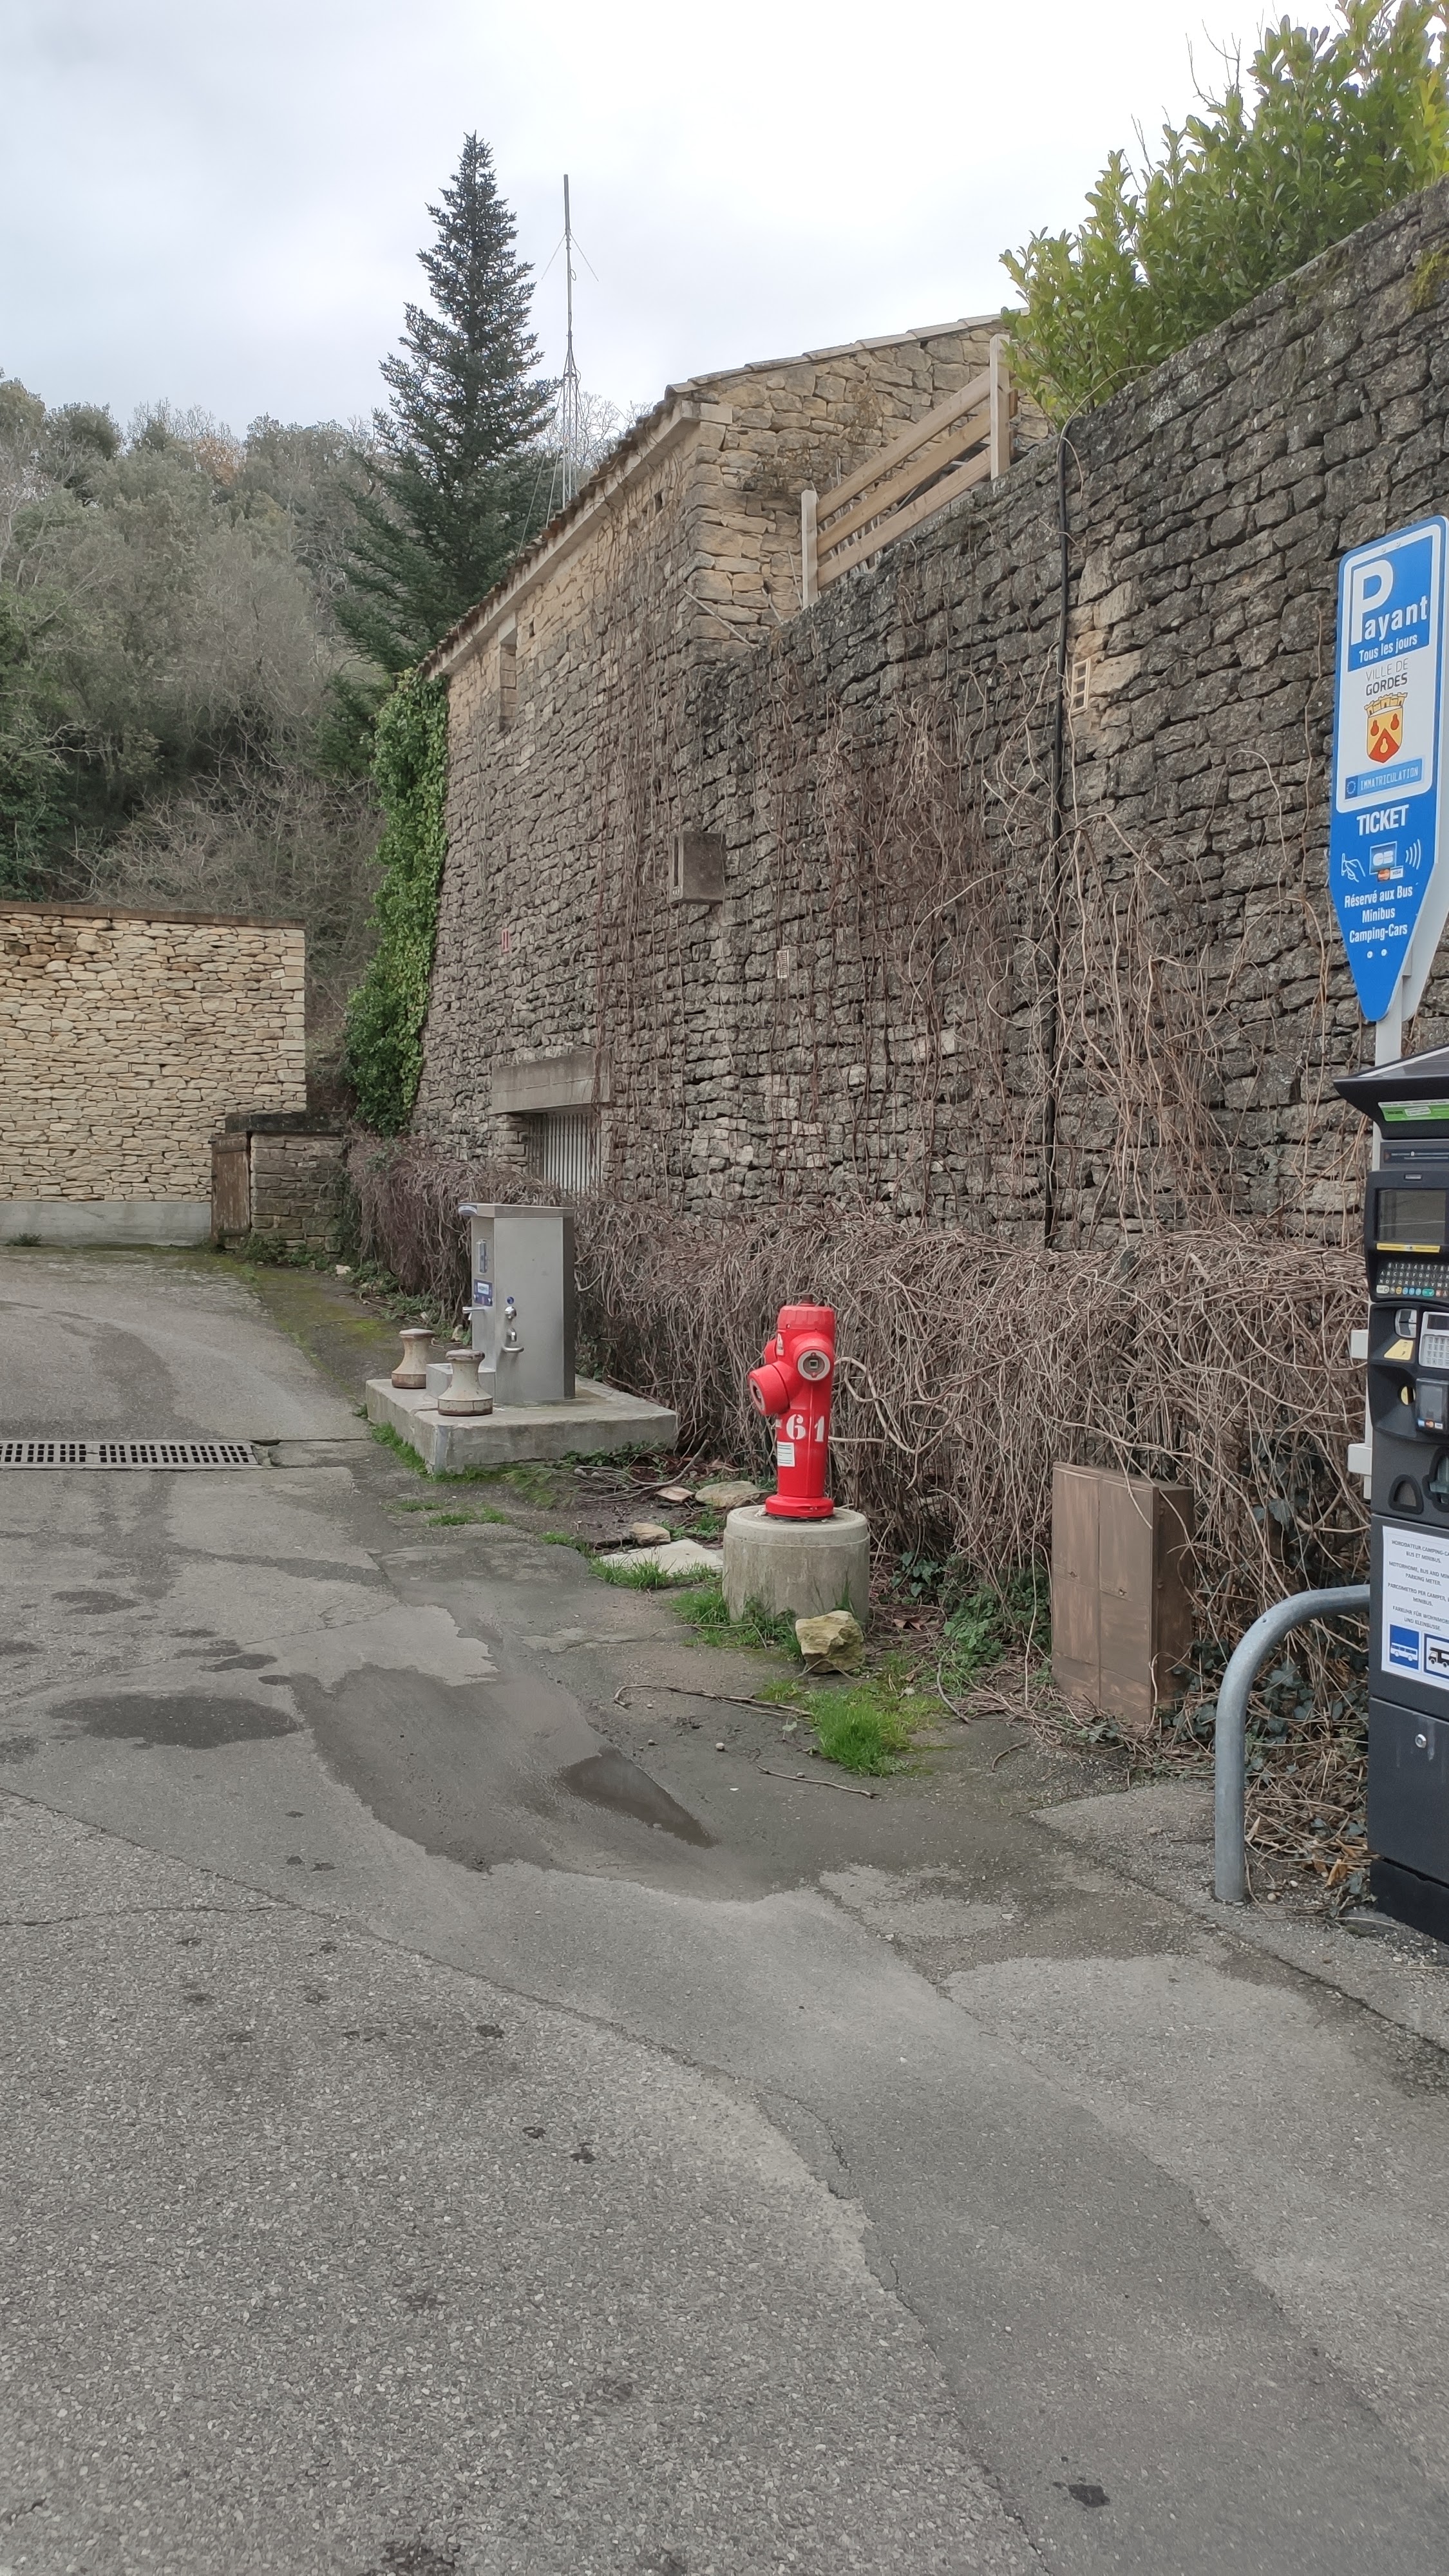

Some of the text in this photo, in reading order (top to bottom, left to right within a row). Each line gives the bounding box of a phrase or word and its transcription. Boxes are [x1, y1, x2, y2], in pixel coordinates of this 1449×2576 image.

[1359, 634, 1417, 663] Tous les jours
[1366, 658, 1408, 682] VILLE DE
[1366, 672, 1408, 696] GORDES
[1360, 767, 1418, 791] IMMATRICULATION
[1356, 804, 1410, 836] TICKET
[1344, 886, 1413, 909] Réservé aux Bus
[1362, 907, 1396, 923] Minibus
[1349, 923, 1408, 943] Camping-Cars
